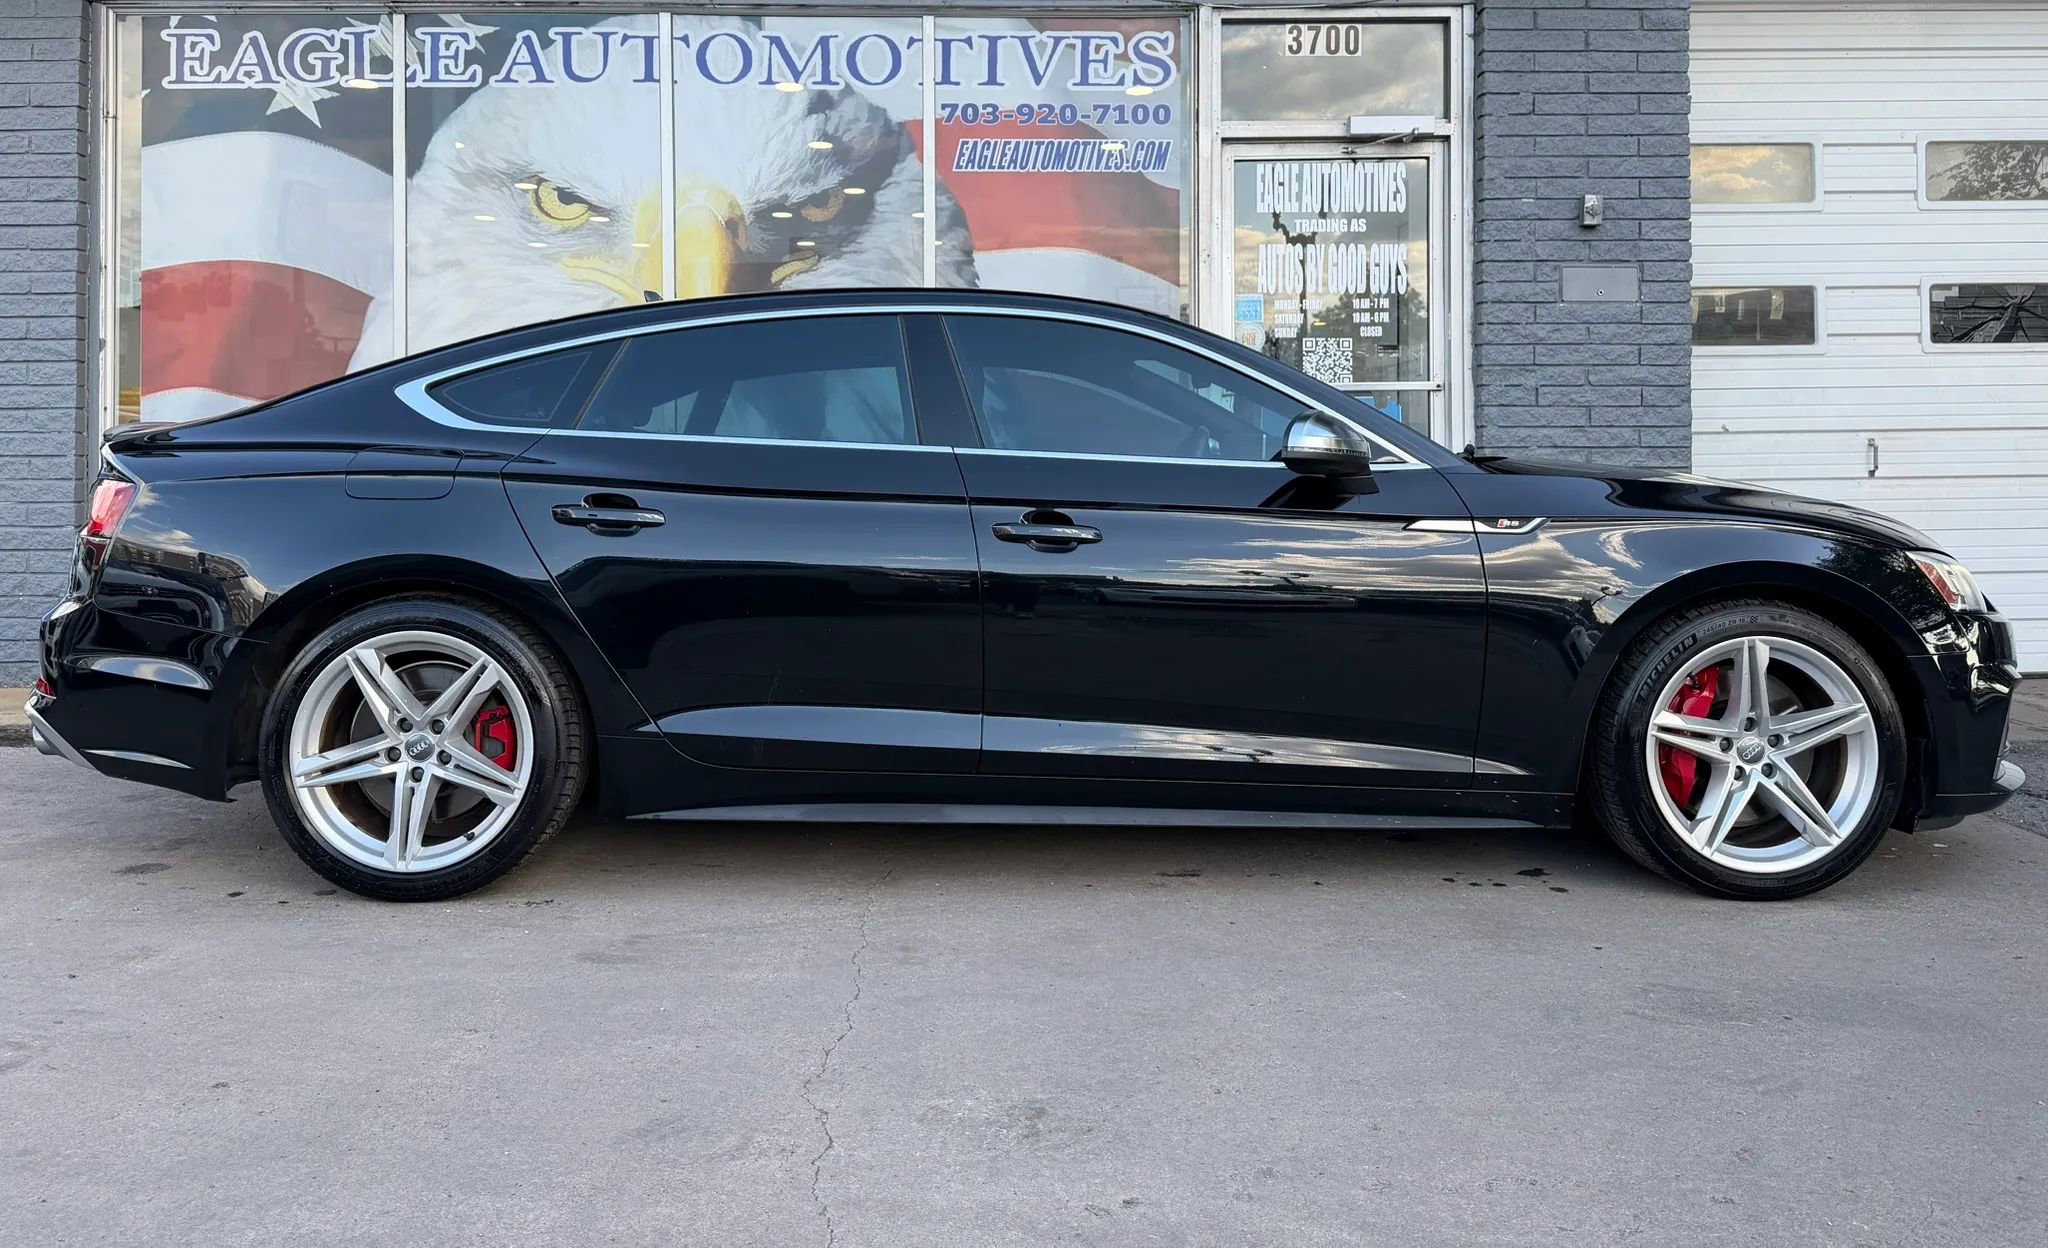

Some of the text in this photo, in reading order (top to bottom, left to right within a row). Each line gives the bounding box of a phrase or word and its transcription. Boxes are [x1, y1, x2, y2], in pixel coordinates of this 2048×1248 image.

[1287, 25, 1360, 55] 3700
[162, 27, 1176, 91] EAGLE AUTOMOTIVES
[940, 102, 1173, 126] 703-920-7100
[953, 138, 1173, 172] EAGLEAUTOMOTIVES.COM
[1256, 162, 1407, 213] EAGLE AUTOMOTIVES
[1294, 218, 1367, 233] TRADING AS
[1258, 243, 1408, 295] AUTOS BY GOOD GUYS
[1352, 298, 1360, 309] 10
[1360, 298, 1370, 309] AM
[1374, 298, 1379, 309] 7
[1380, 298, 1389, 309] PM
[1274, 313, 1304, 324] SATURDAY
[1352, 312, 1360, 323] 10
[1360, 312, 1370, 323] AM
[1380, 312, 1389, 323] PM
[1274, 327, 1298, 338] SUNDAY
[1360, 326, 1383, 337] CLOSED
[1640, 634, 1696, 698] MICHELIN
